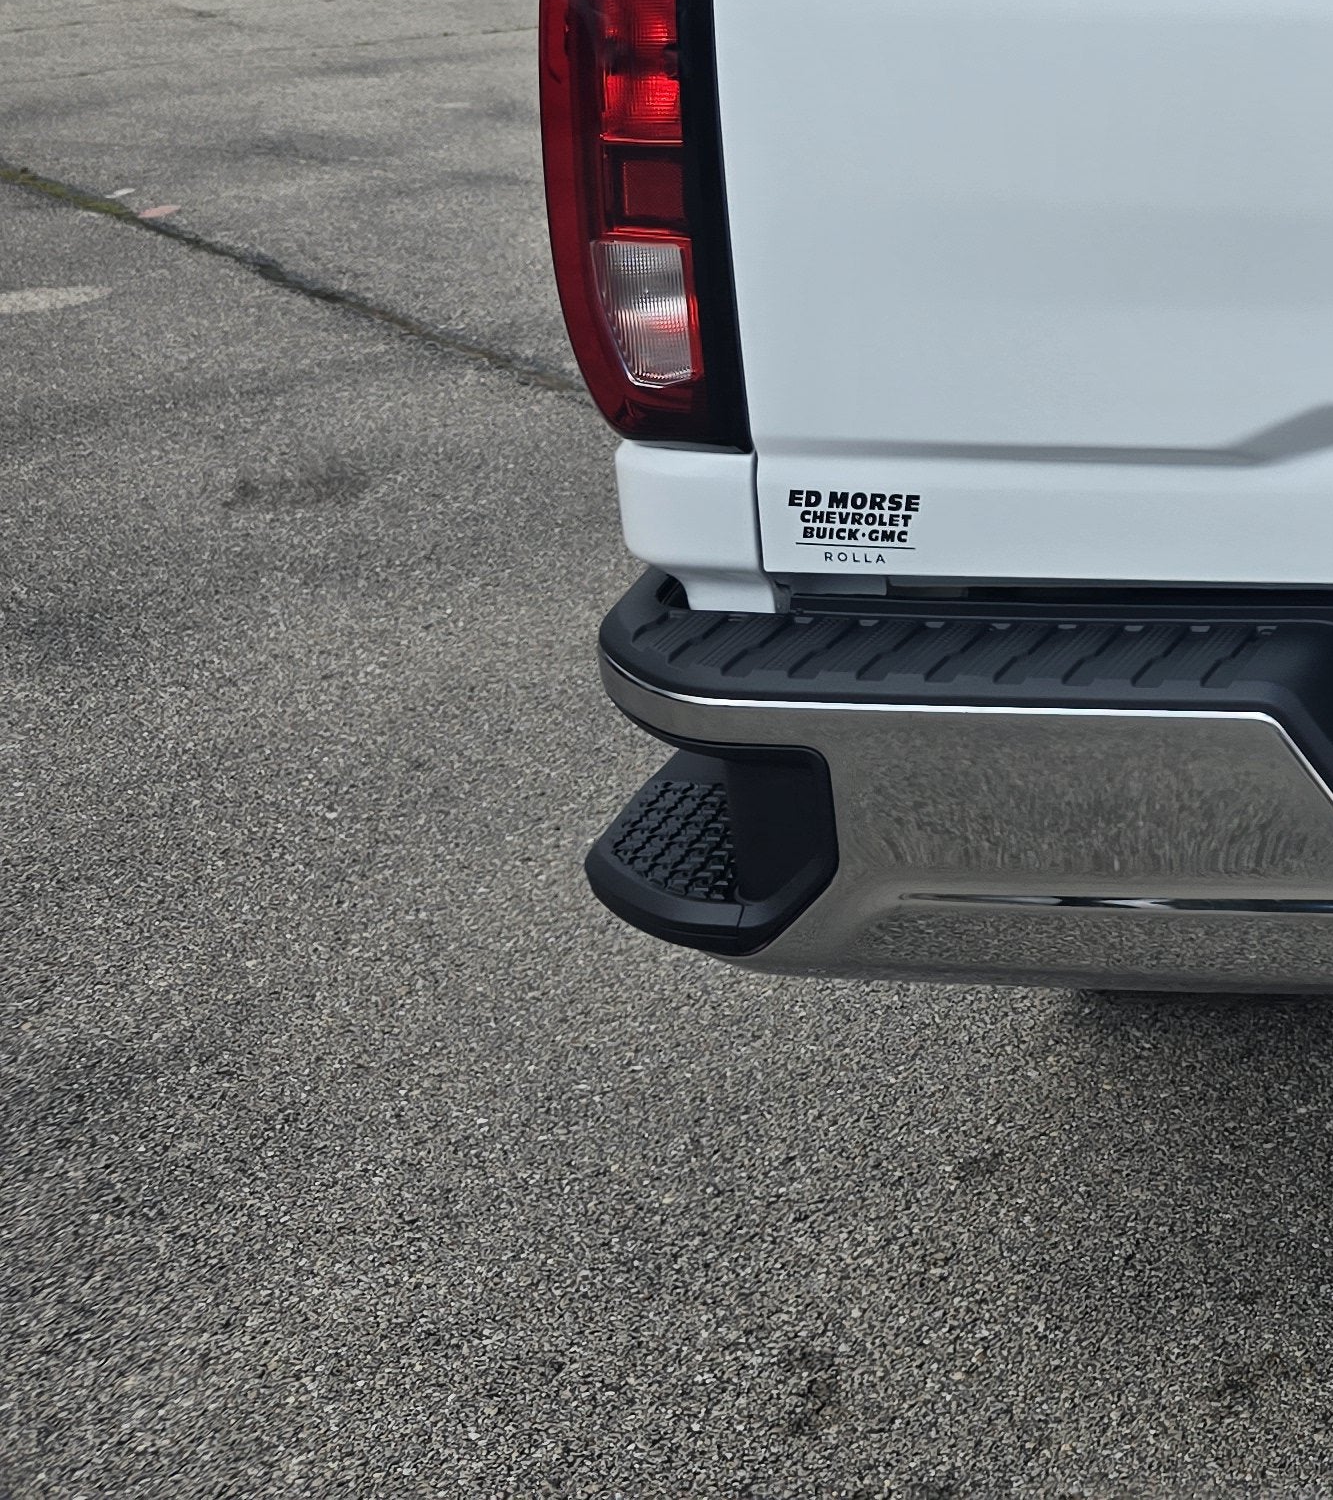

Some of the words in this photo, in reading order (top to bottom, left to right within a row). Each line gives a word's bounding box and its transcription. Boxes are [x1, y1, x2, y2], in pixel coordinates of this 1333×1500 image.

[788, 489, 822, 508] ED
[827, 491, 921, 512] MORSE
[799, 510, 913, 528] CHEVROLET
[824, 551, 886, 564] ROLLA
